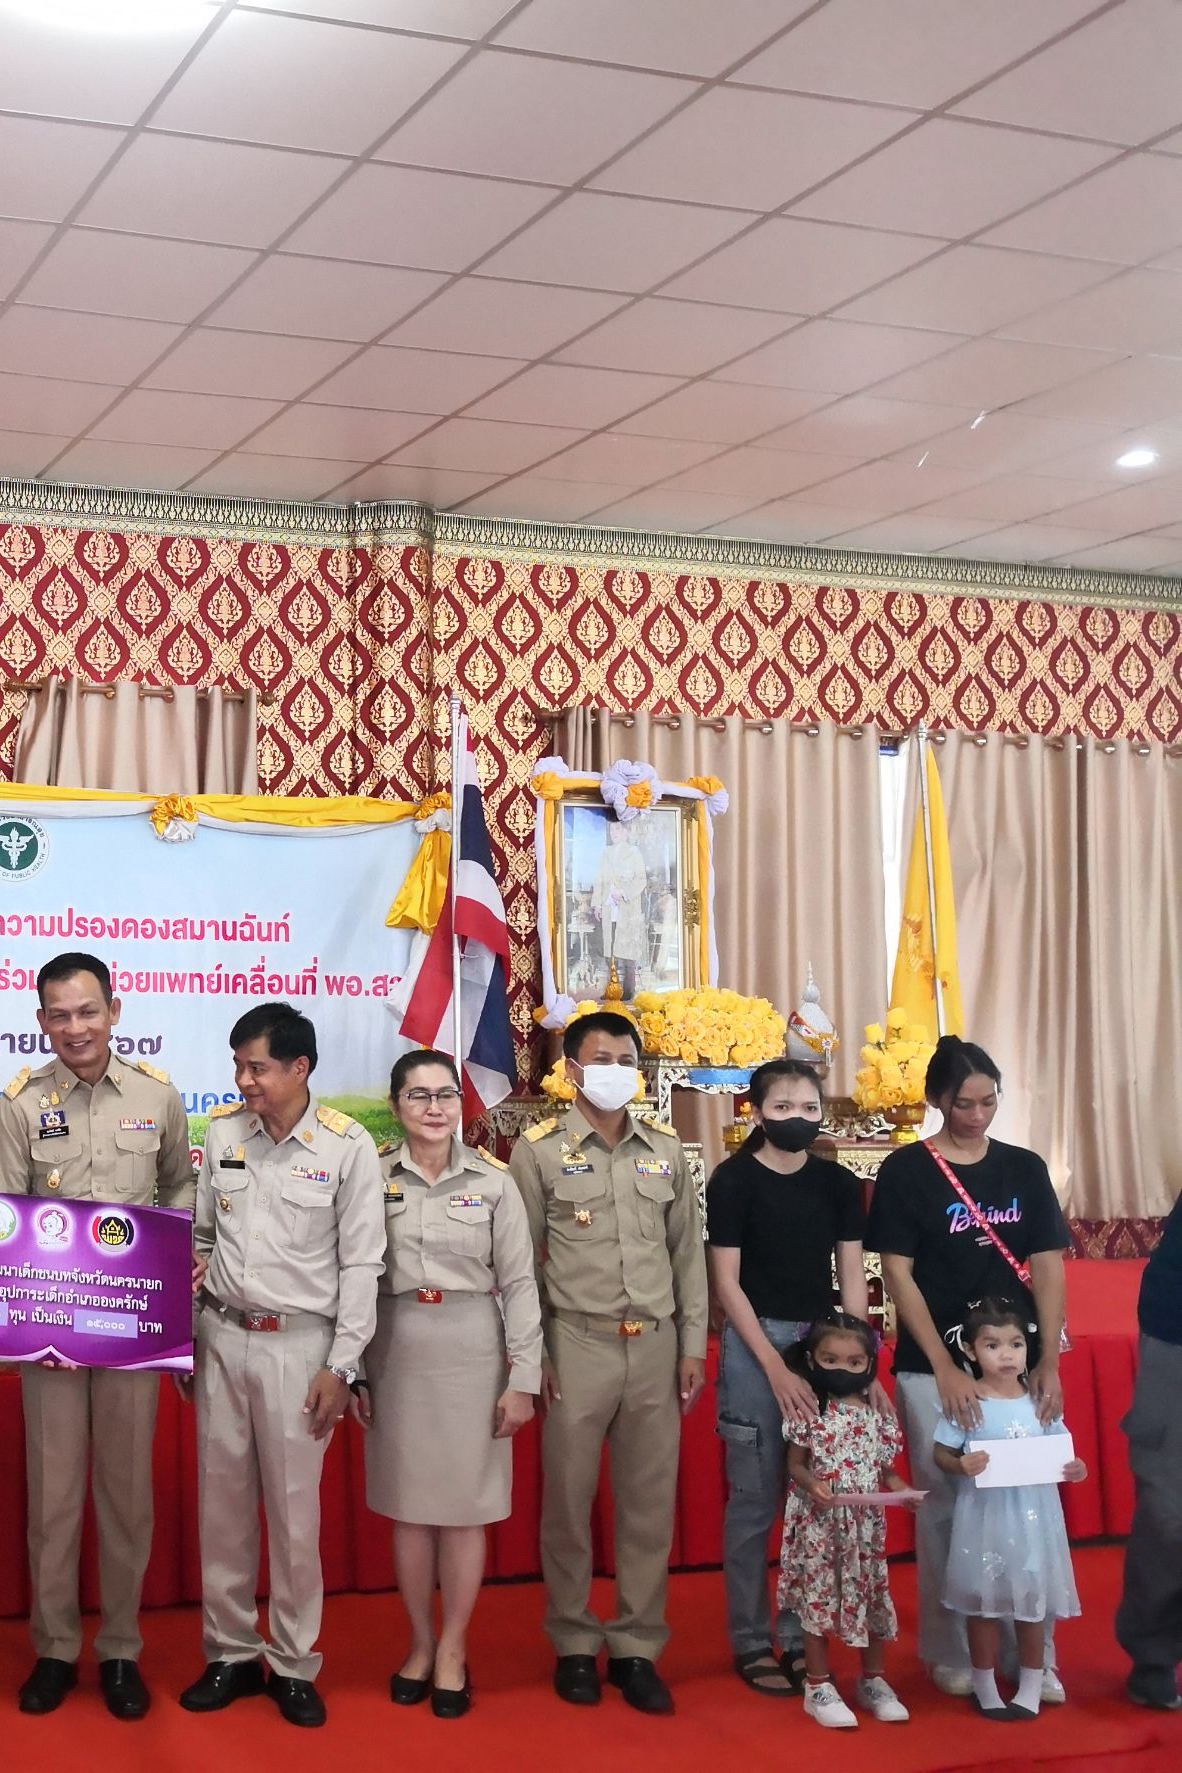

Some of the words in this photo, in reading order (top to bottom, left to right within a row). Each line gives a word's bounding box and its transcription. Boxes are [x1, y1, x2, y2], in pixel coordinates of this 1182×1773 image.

[9, 1309, 26, 1325] ทุน
[31, 1306, 72, 1326] เป็นเงิน
[138, 1321, 163, 1334] บาท
